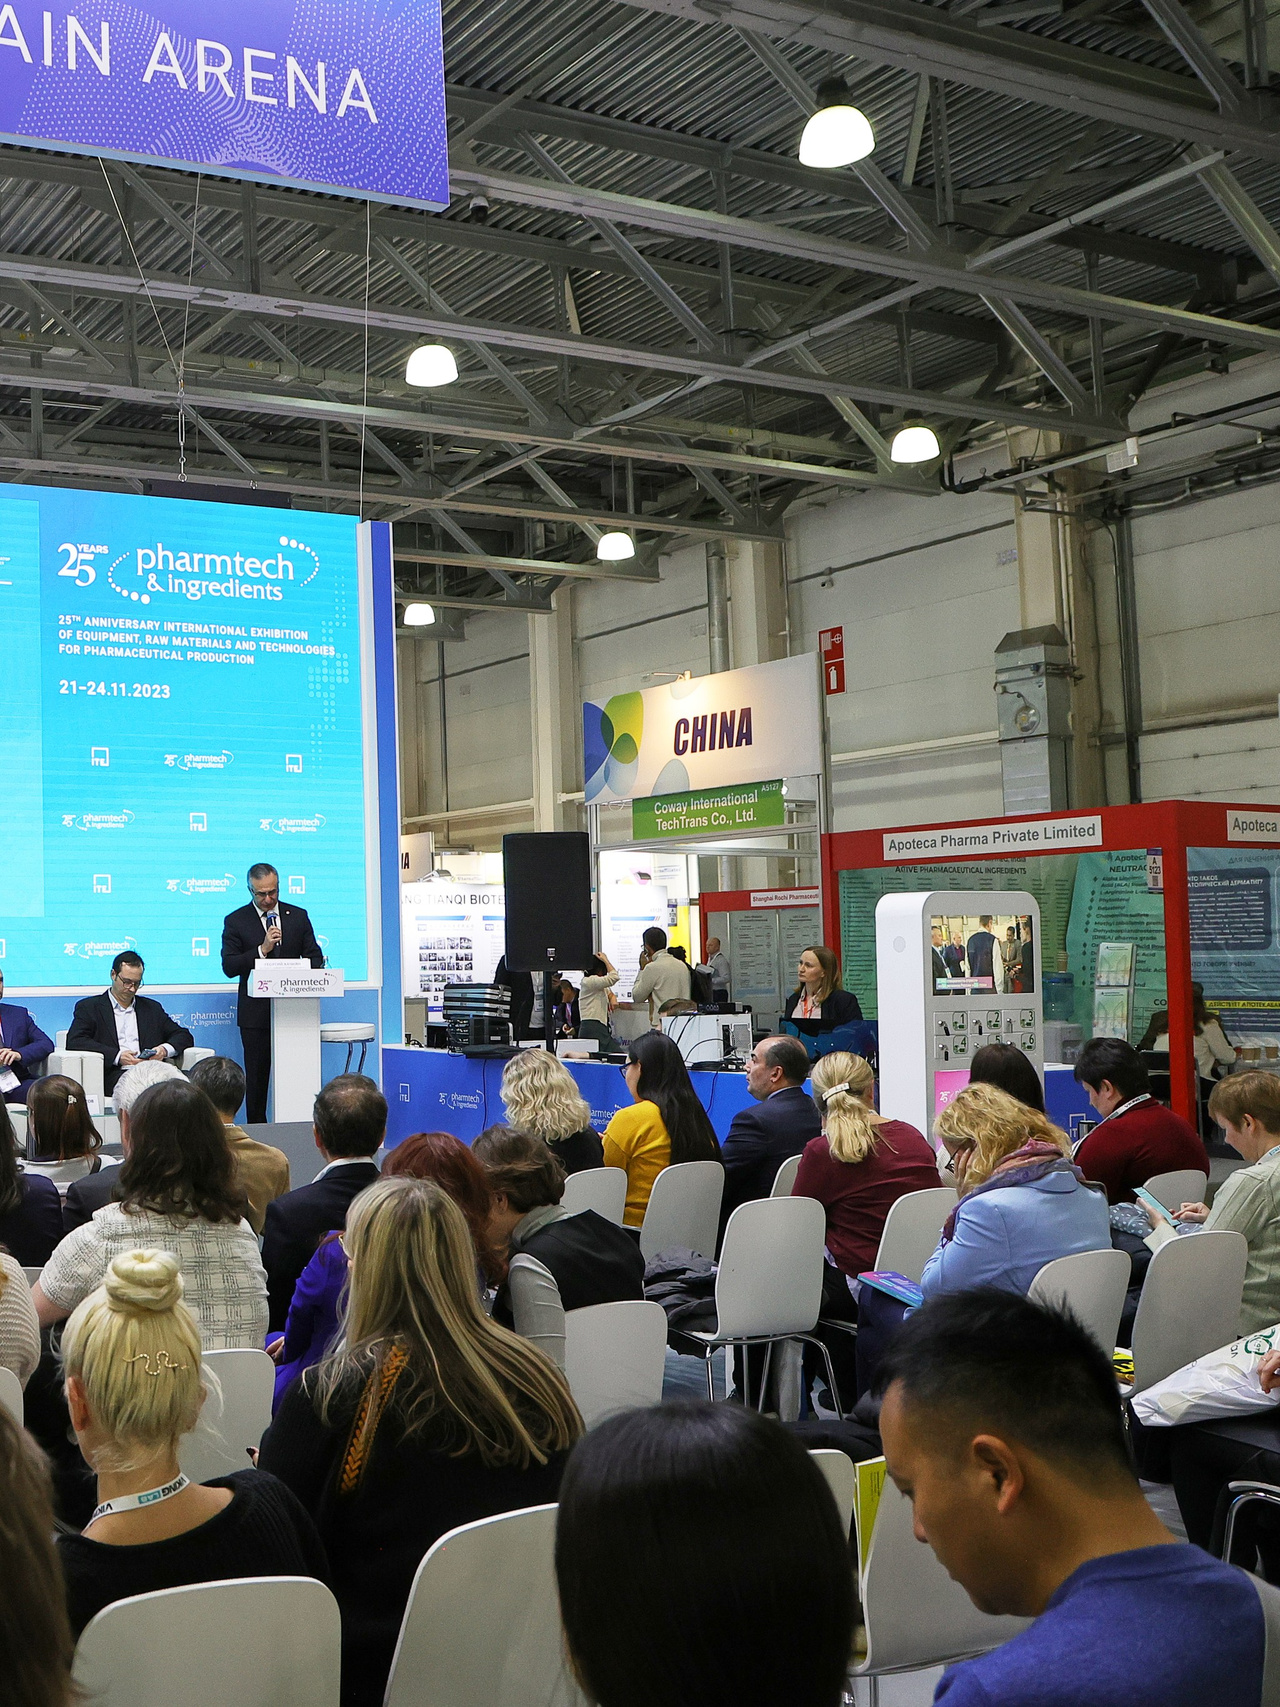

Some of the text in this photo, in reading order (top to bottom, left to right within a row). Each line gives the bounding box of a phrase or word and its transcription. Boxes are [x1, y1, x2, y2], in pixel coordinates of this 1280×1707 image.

[141, 30, 379, 123] ARENA
[76, 543, 109, 554] YEARS
[57, 543, 96, 587] 25
[136, 543, 294, 580] pharmtech
[147, 573, 283, 601] & ingredients
[84, 616, 160, 631] ANNIVERSARY
[164, 621, 248, 637] INTERNATIONAL
[251, 626, 308, 640] EXHIBITION
[59, 629, 335, 656] OF EQUIPMENT, RAW MATERIALS AND TECHNOLOGIES
[59, 644, 255, 665] FOR PHARMACEUTICAL PRODUCTION
[673, 707, 753, 756] CHINA
[761, 783, 779, 792] A5127
[654, 790, 758, 816] Coway International
[656, 808, 757, 831] TechTrans Co., Ltd.
[1232, 817, 1278, 834] Apoteca
[889, 822, 1096, 853] Apoteca Pharma Private Limited
[1152, 857, 1157, 865] A
[1149, 865, 1161, 875] 5123
[427, 894, 466, 905] TIANQI
[752, 894, 774, 903] Shanghai
[774, 893, 789, 901] Rochi
[280, 978, 329, 988] pharmtech
[290, 986, 326, 994] ingredients
[191, 1011, 235, 1022] pharmtech
[994, 1012, 1000, 1022] 2
[1028, 1011, 1034, 1021] 3
[960, 1037, 966, 1047] 4
[1029, 1034, 1034, 1044] 6
[451, 1092, 480, 1104] pharmtech
